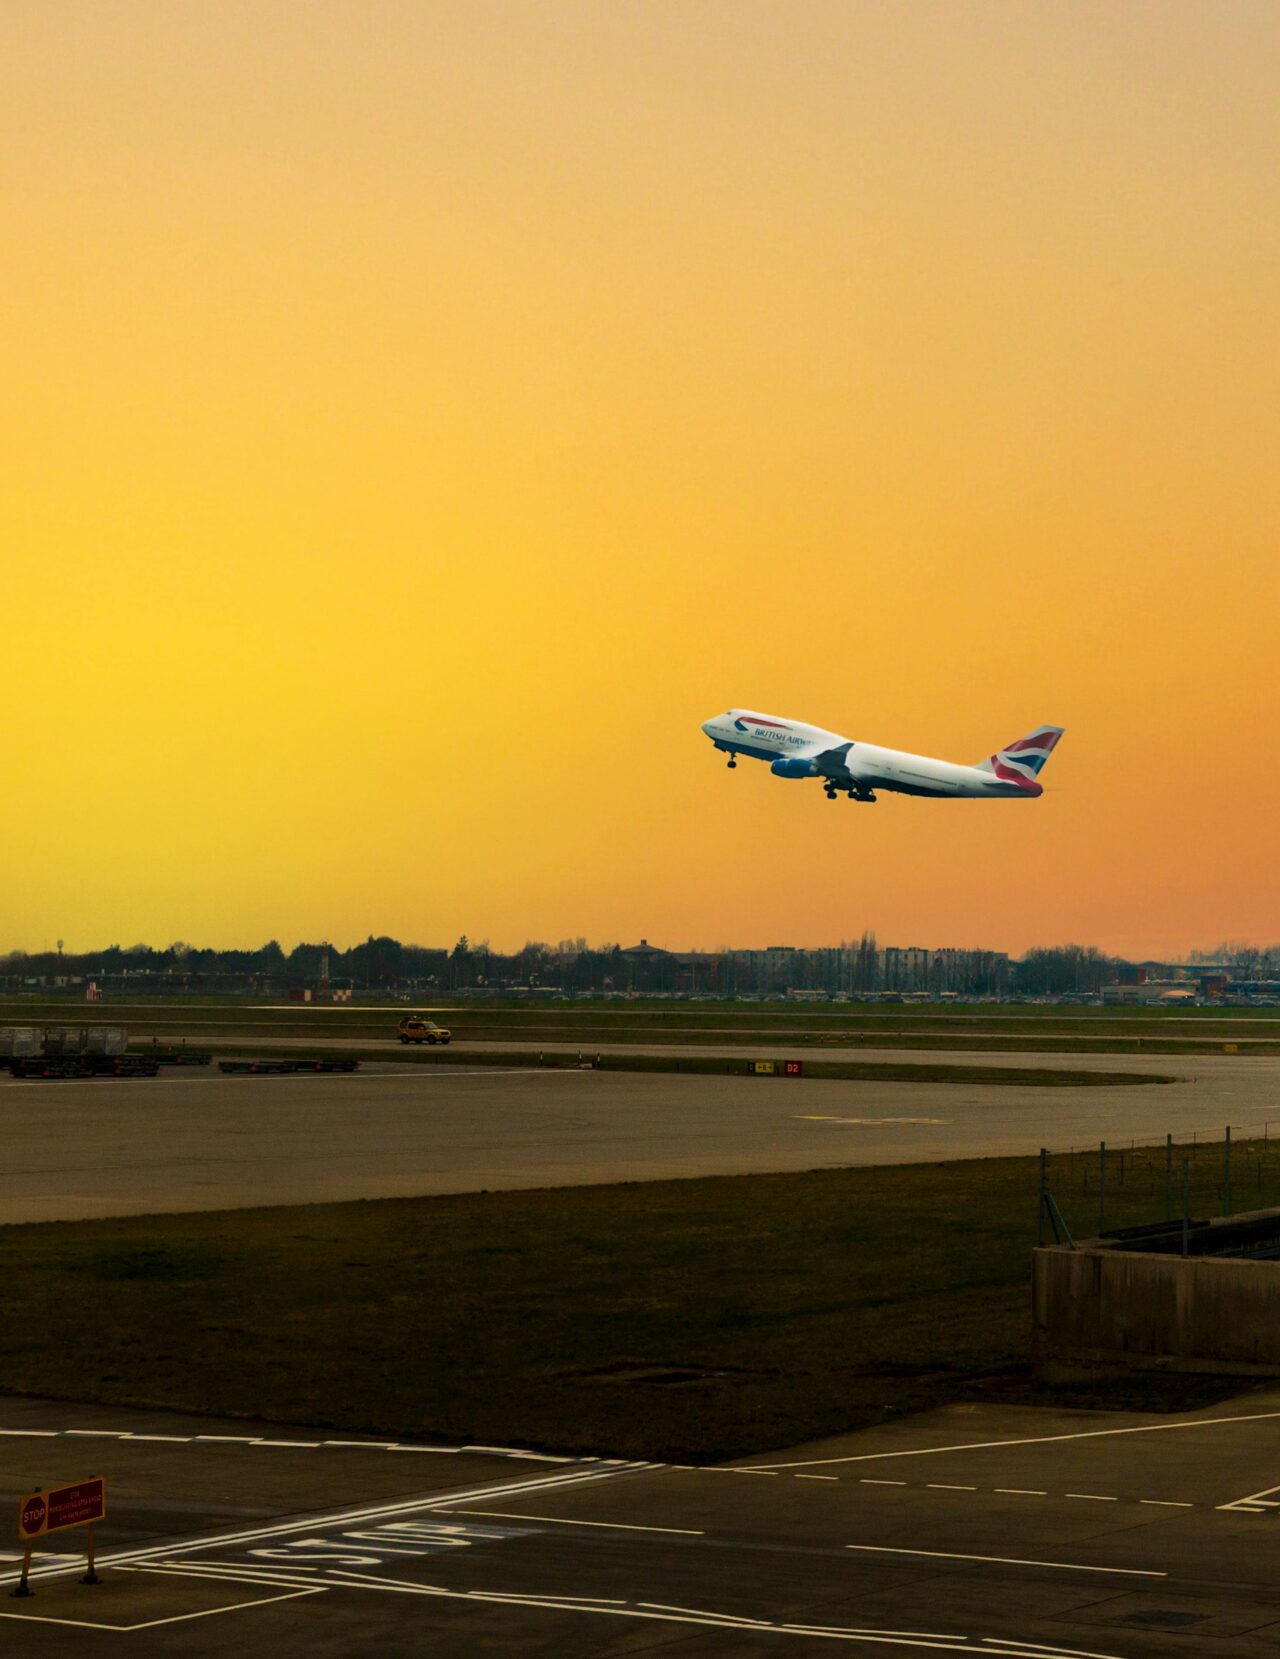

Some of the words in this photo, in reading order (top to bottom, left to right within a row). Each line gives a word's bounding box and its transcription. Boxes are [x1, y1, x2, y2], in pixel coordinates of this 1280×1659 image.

[755, 728, 786, 742] BRITISH
[787, 1063, 799, 1073] D2
[24, 1508, 45, 1523] STOP
[247, 1522, 506, 1565] STOP
